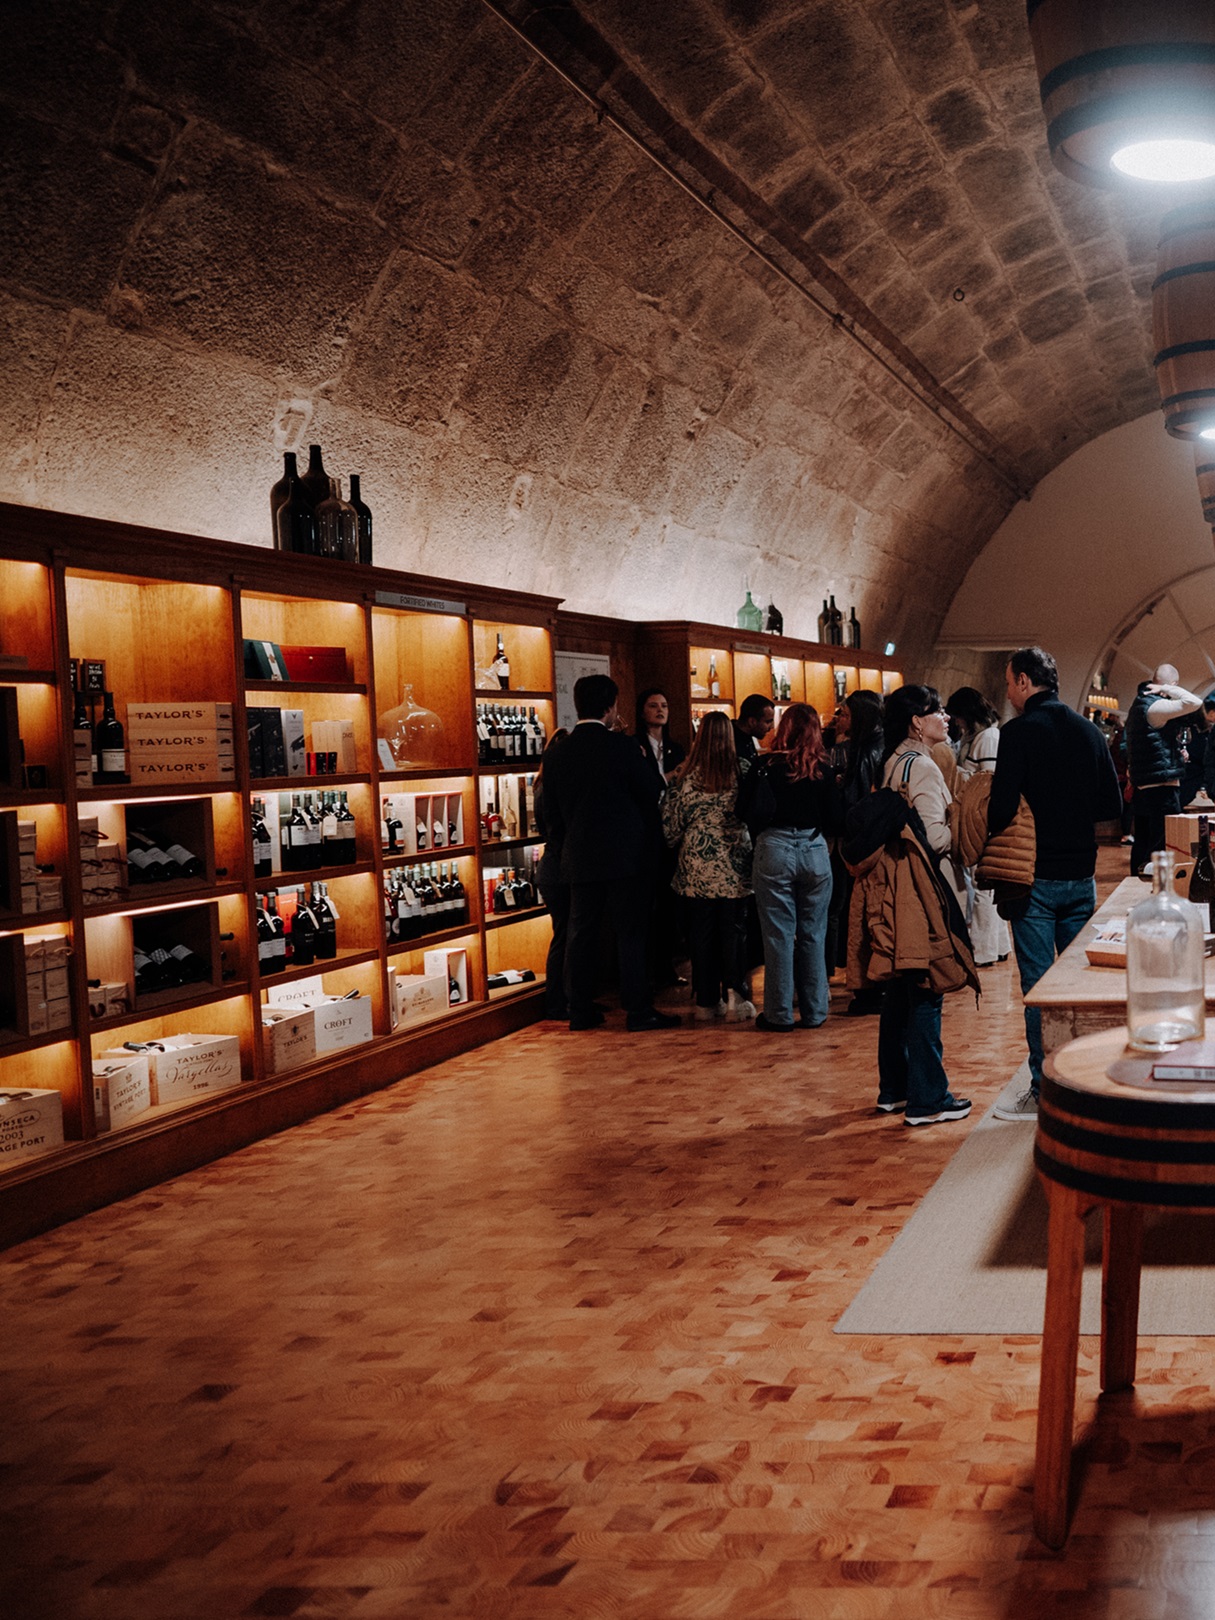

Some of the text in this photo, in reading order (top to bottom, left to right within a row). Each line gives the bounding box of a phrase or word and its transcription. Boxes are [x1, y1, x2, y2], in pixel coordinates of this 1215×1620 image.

[401, 596, 445, 610] FORTIFIED WHITES
[136, 710, 204, 720] TAYLOR'S
[138, 737, 206, 746] TAYLOR'S
[139, 763, 207, 773] TAYLOR'S
[324, 1018, 353, 1030] CROFT
[177, 1051, 223, 1064] TAYLOR'S
[0, 1131, 23, 1144] 2003
[21, 1136, 45, 1148] PORT
